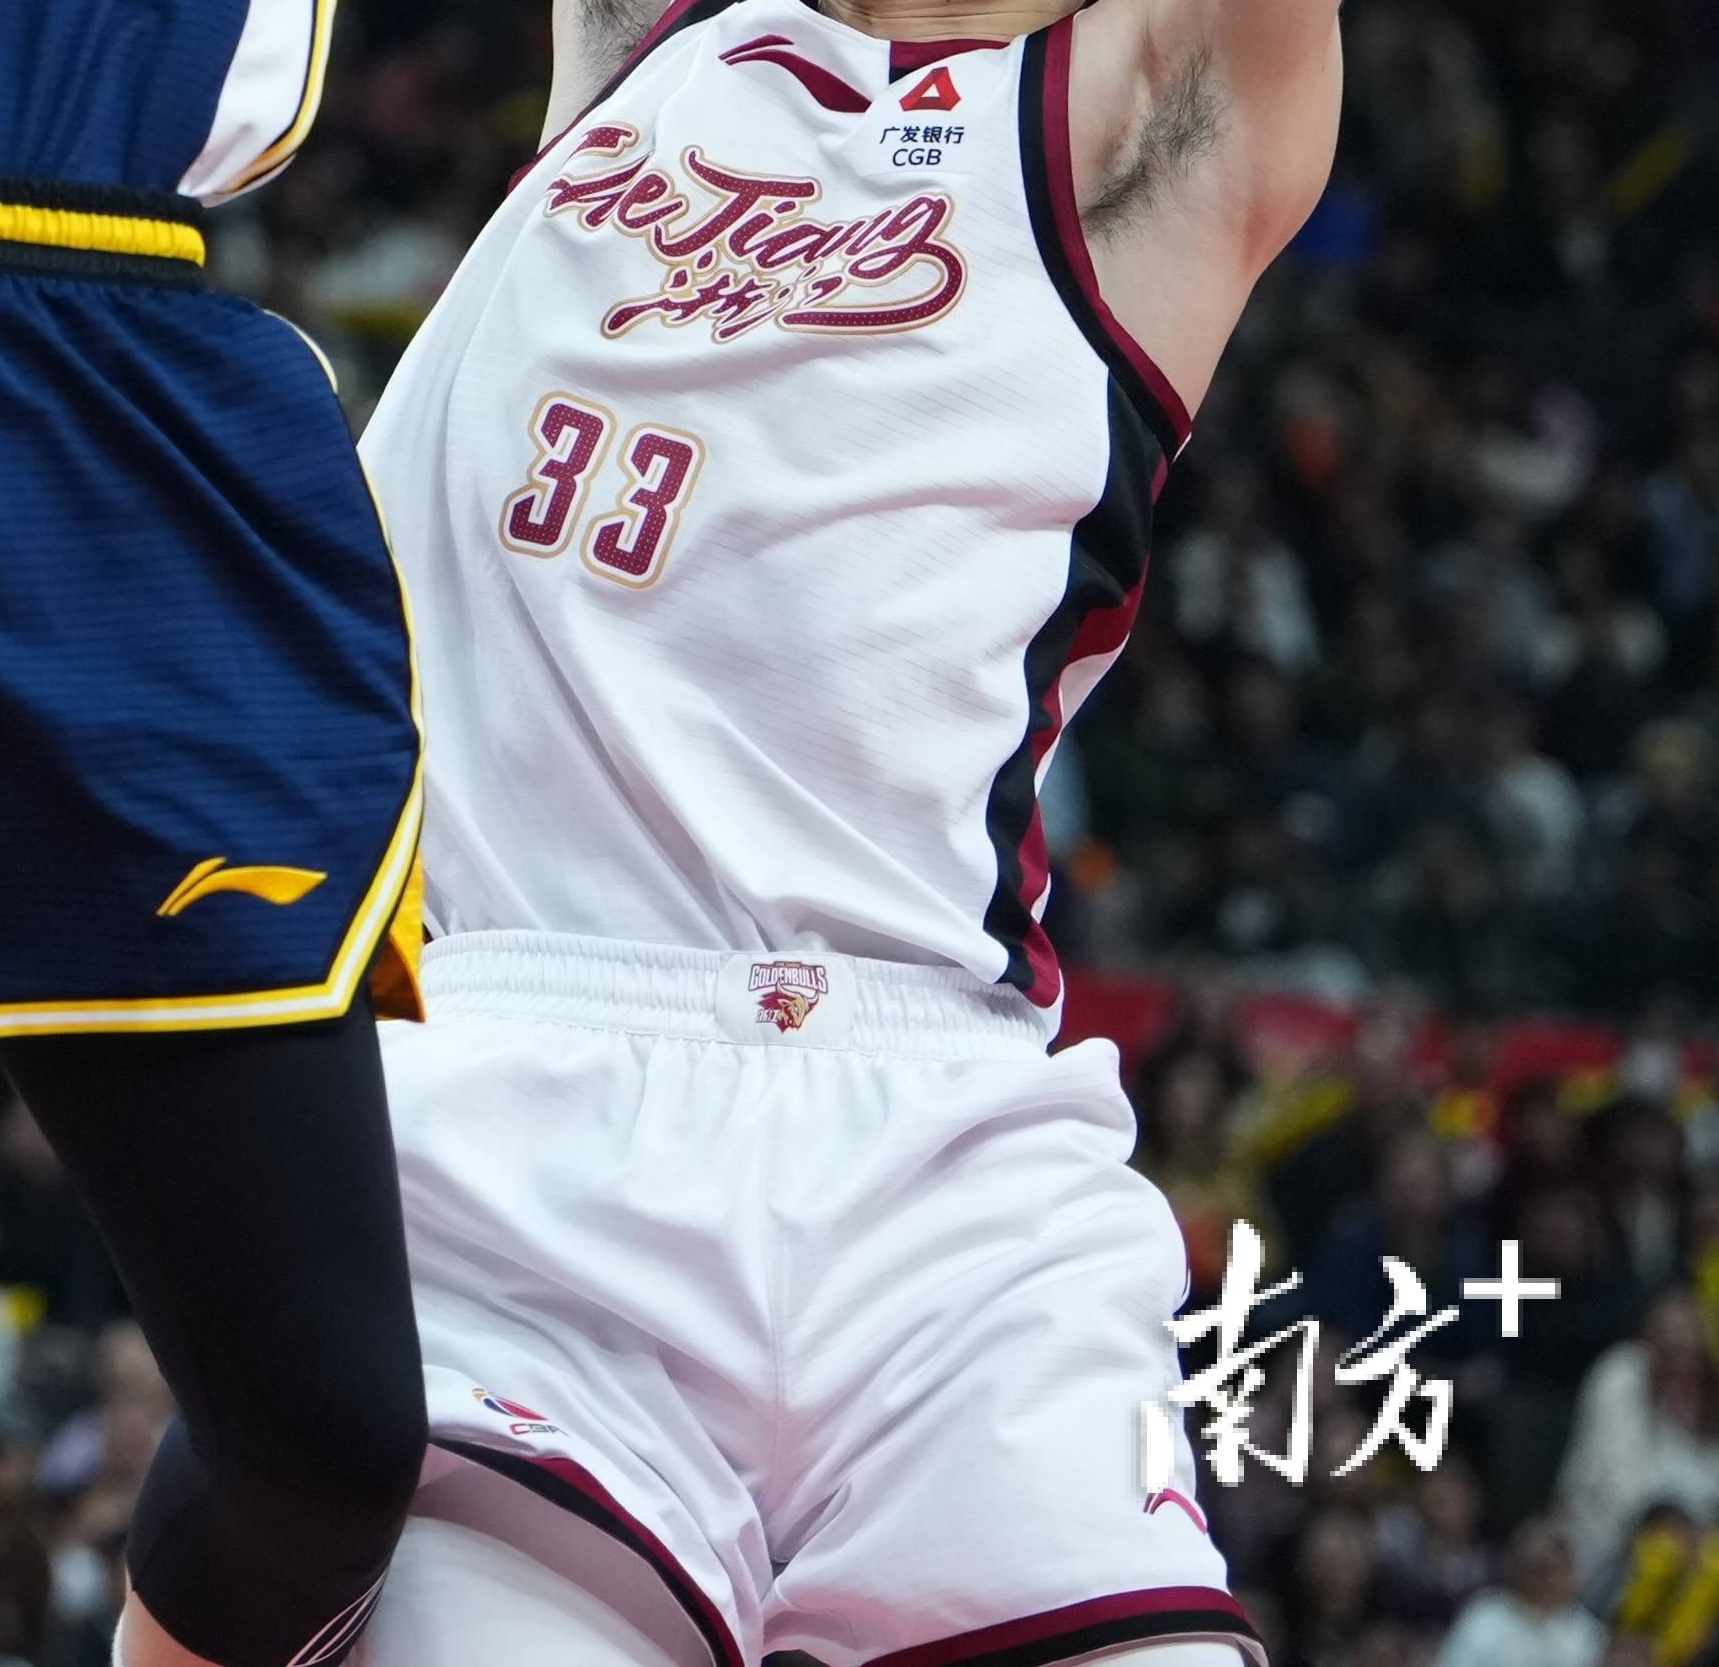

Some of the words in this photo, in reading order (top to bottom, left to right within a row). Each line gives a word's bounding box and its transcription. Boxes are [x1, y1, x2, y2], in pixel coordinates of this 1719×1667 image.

[879, 126, 965, 144] 广发银行
[892, 148, 942, 167] CGB
[498, 391, 706, 590] 33
